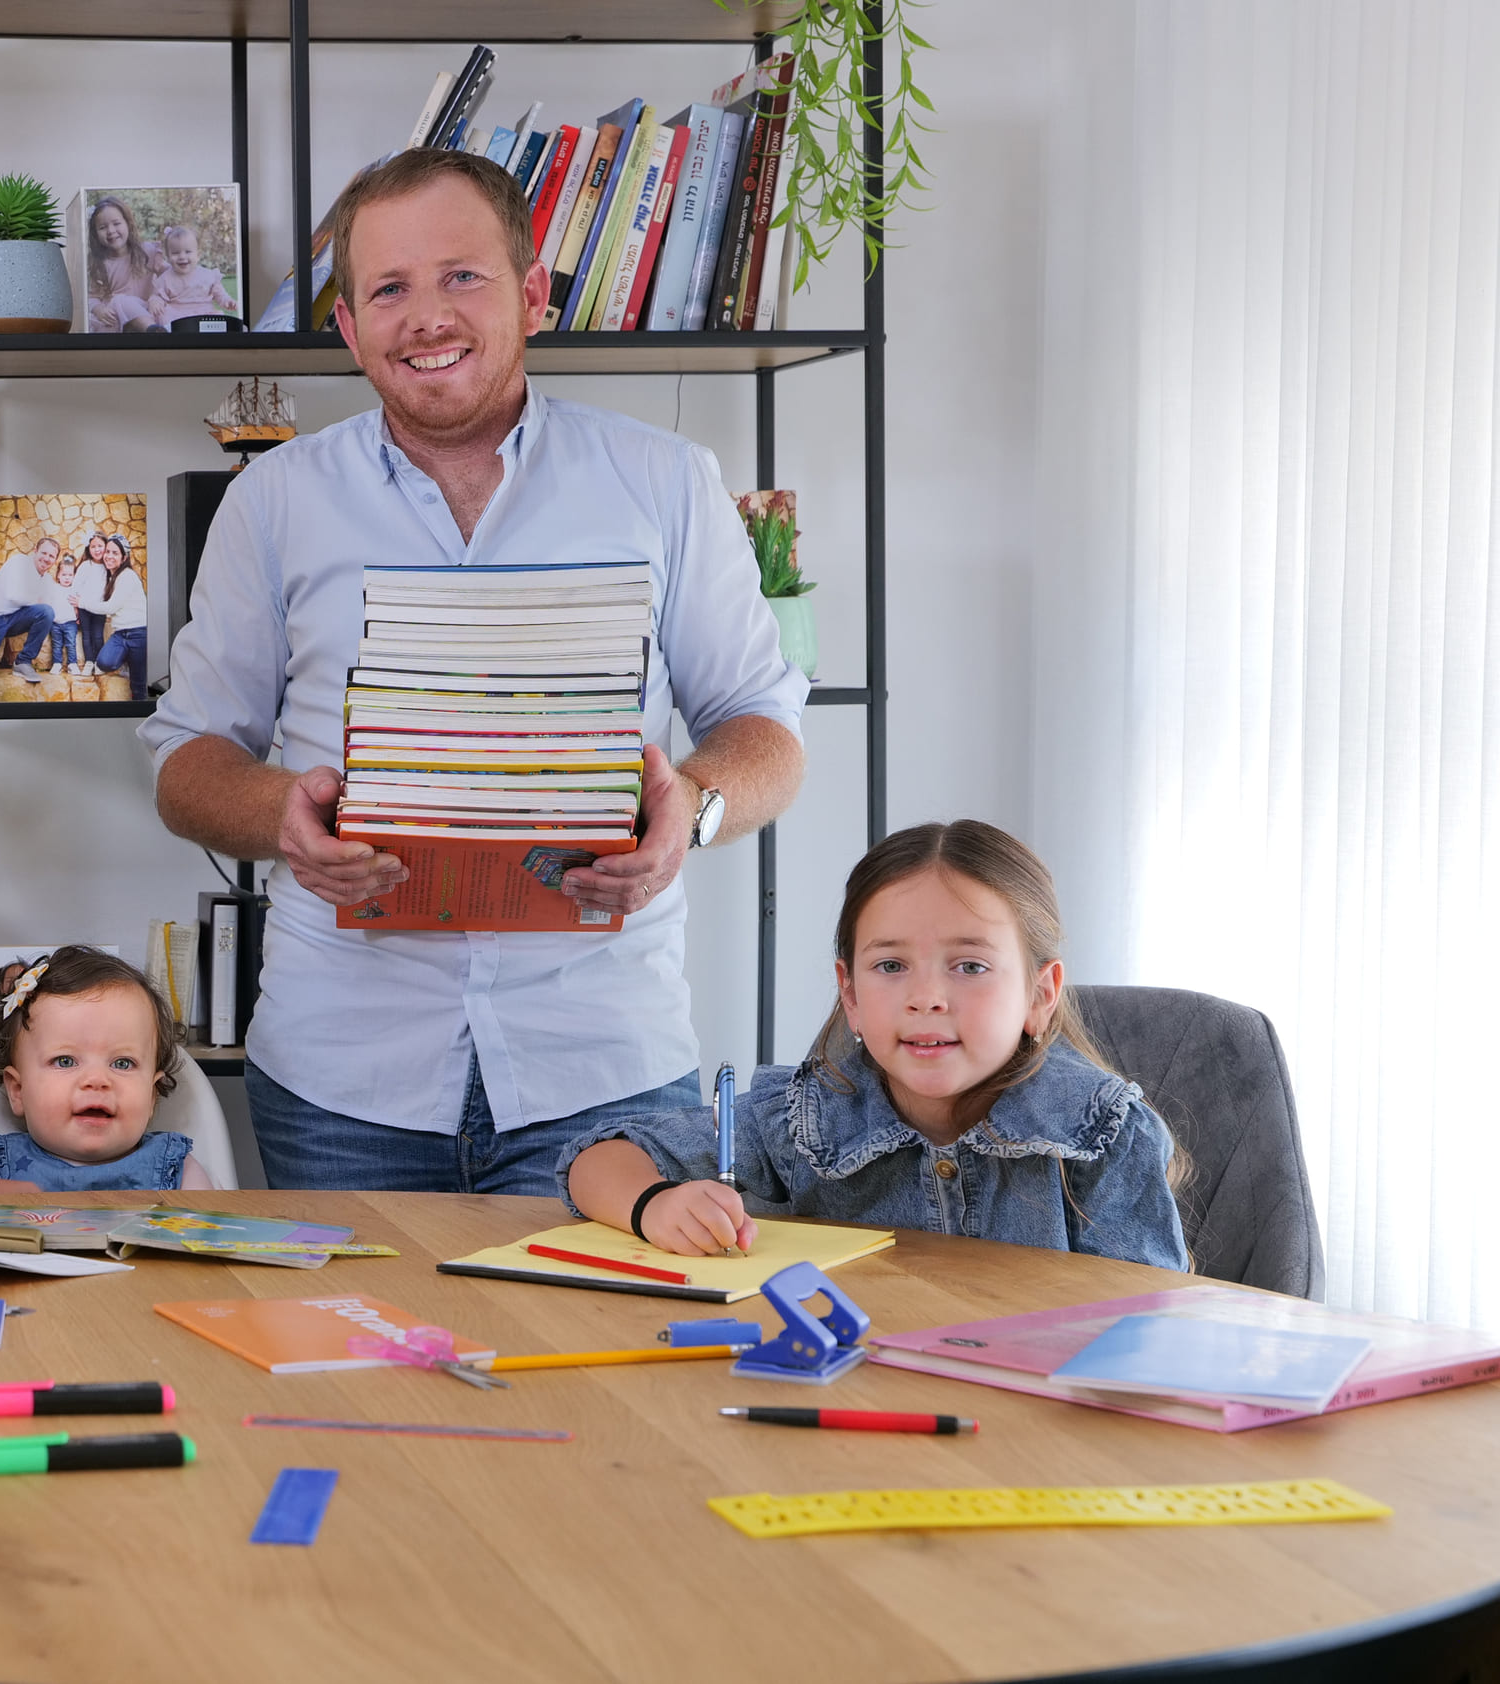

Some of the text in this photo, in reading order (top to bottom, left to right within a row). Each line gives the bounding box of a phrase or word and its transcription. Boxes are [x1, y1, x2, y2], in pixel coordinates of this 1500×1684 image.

[689, 118, 713, 180] יצחק נבון
[749, 117, 766, 173] מאסטר שף
[590, 159, 607, 186] רון לשם
[639, 163, 660, 202] אמנדה
[719, 159, 730, 179] איש
[757, 130, 782, 224] אוסף המתכונים שלי
[681, 183, 699, 223] כל הדרך
[713, 180, 725, 206] ואשה
[631, 203, 652, 232] קוויק
[737, 193, 751, 238] ספר המתכונים
[620, 242, 639, 273] המעגל
[610, 273, 630, 308] השלישי
